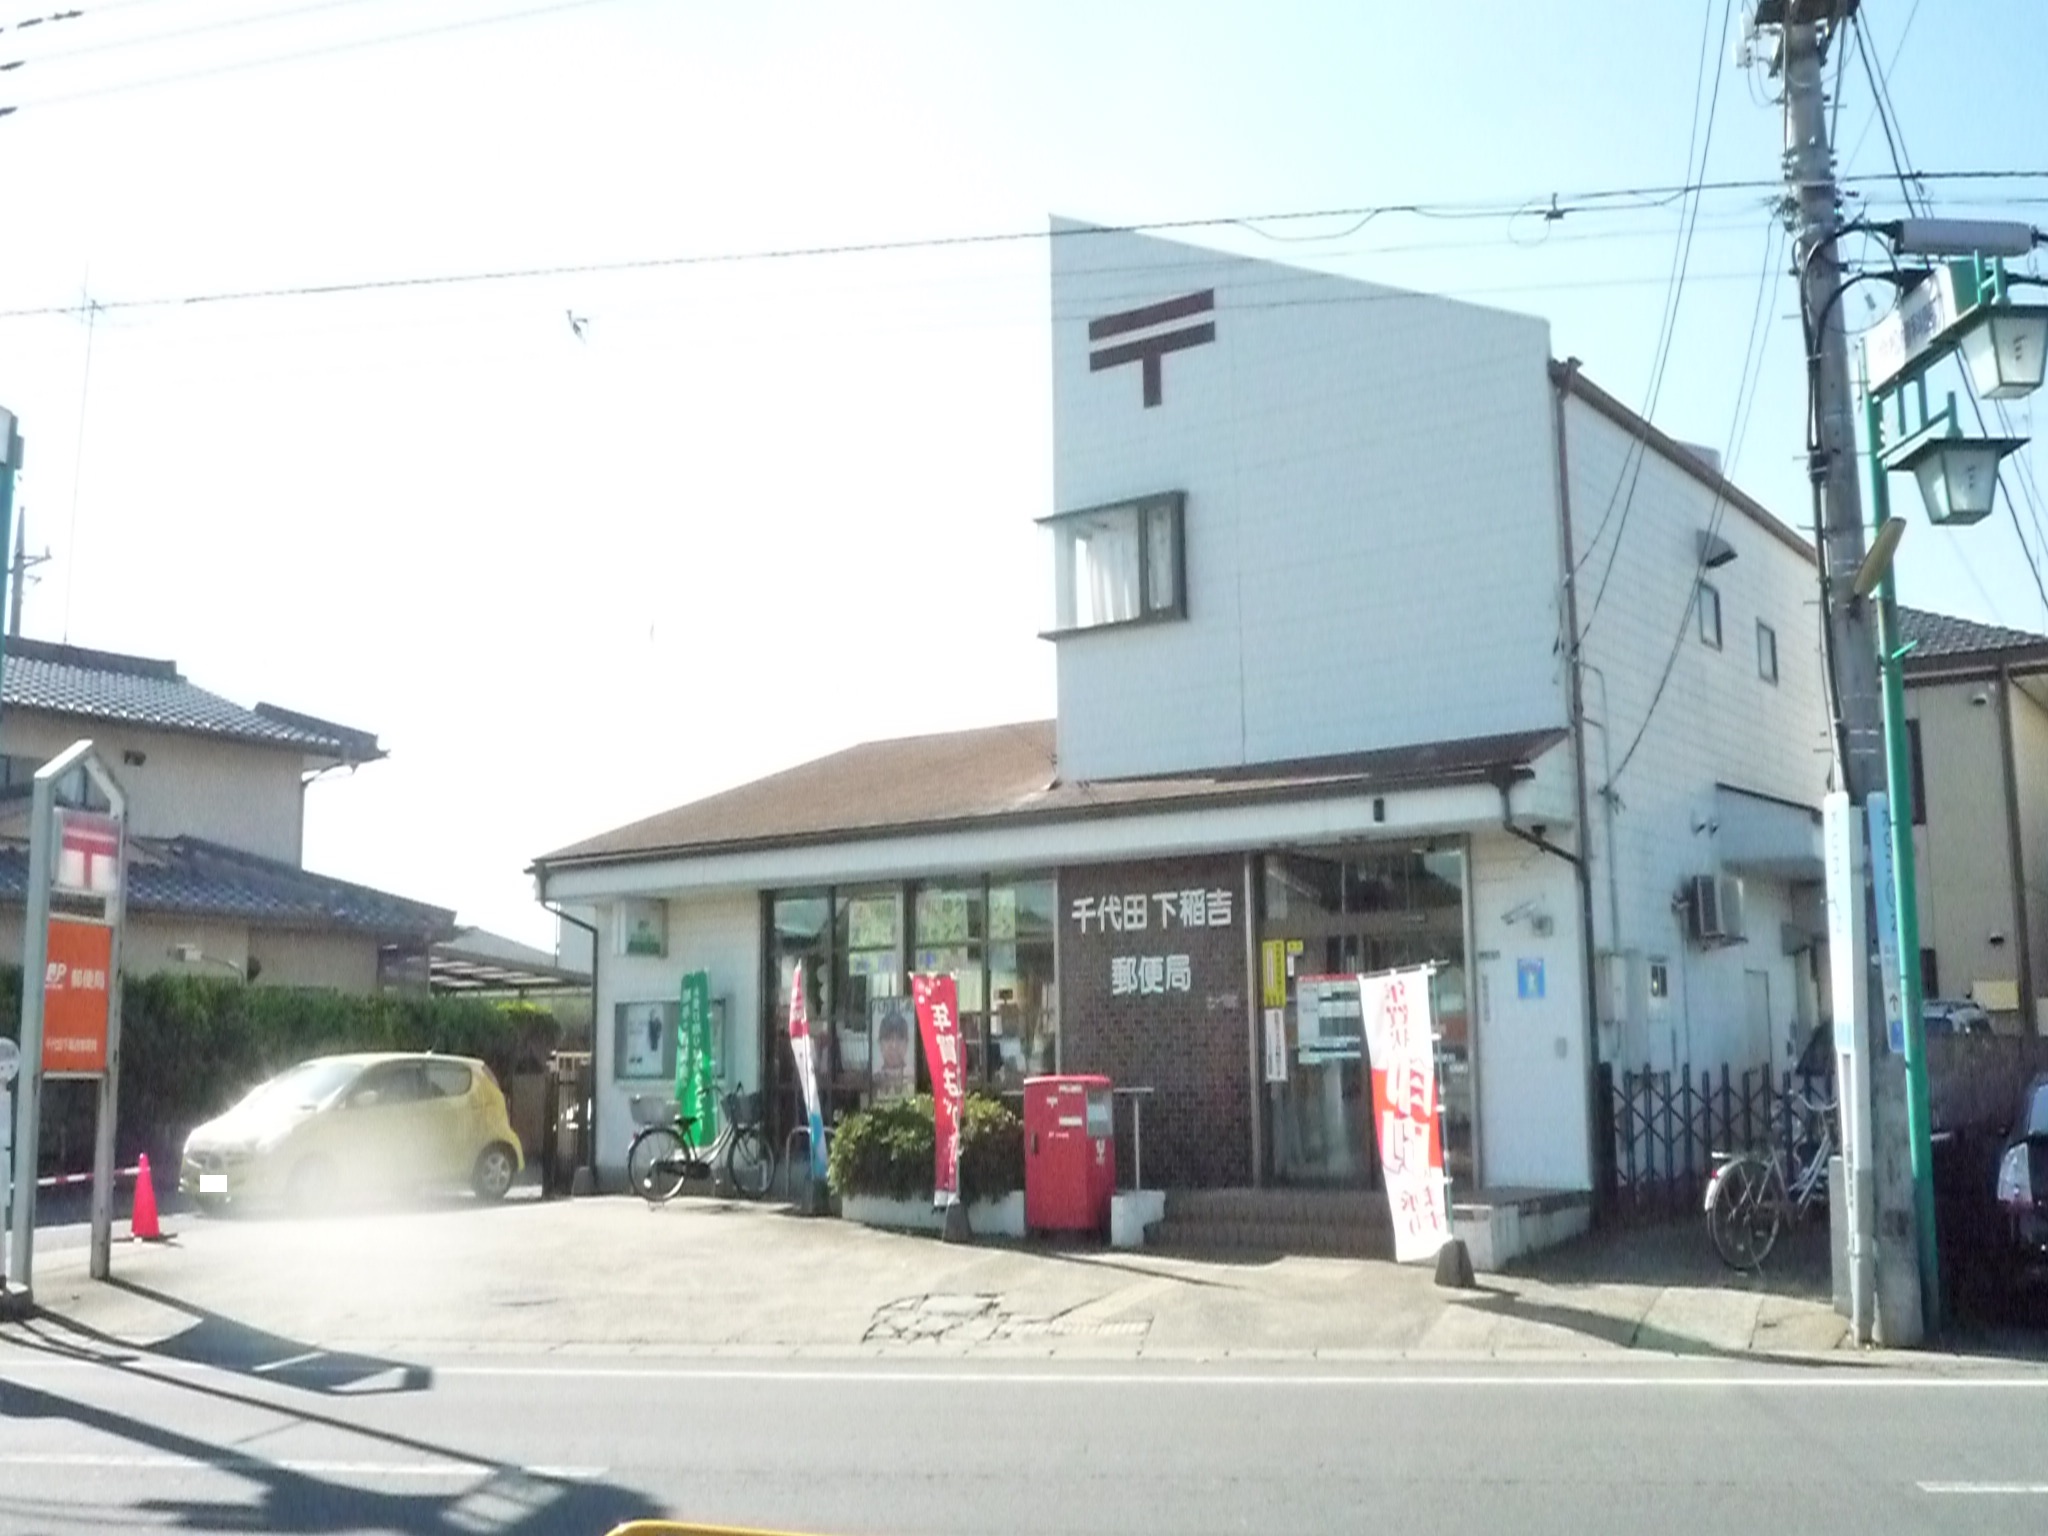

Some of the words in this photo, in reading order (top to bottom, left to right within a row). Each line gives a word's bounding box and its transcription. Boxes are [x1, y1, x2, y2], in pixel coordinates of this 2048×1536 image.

[1071, 888, 1233, 933] 千代田下稲吉
[1110, 954, 1192, 995] 郵便局
